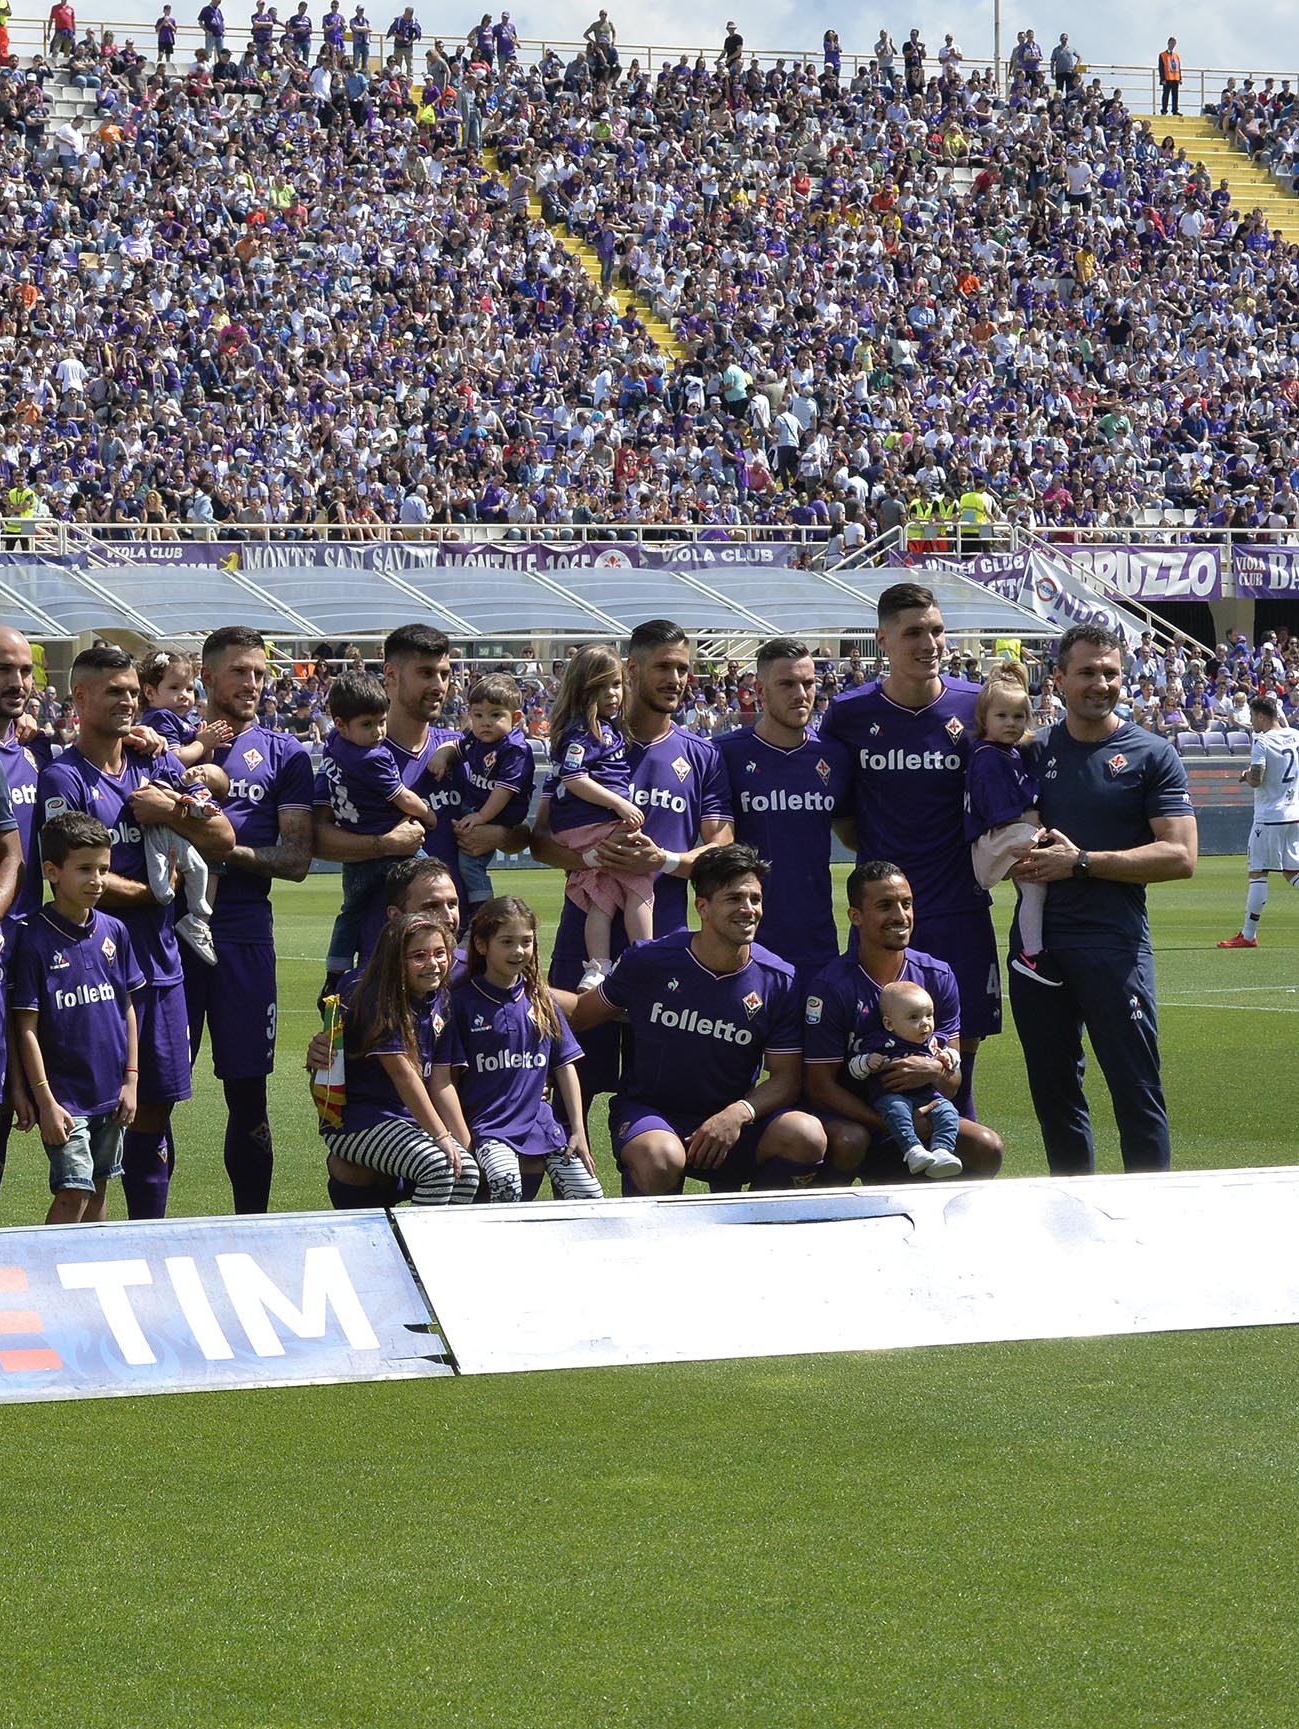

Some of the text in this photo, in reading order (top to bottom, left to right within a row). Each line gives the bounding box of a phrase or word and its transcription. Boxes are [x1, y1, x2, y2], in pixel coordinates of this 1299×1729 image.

[150, 547, 182, 558] CLUB
[245, 547, 316, 569] MONTE
[325, 548, 365, 569] SAN
[661, 549, 773, 562] VIOLA CLUB
[980, 555, 1024, 573] CLUB
[1236, 557, 1267, 571] VIOLA
[1238, 572, 1263, 586] CLUB
[860, 748, 961, 771] folletto
[1045, 770, 1057, 779] 40
[741, 789, 835, 813] folletto
[650, 1003, 752, 1046] folletto
[56, 1247, 381, 1365] TIM
